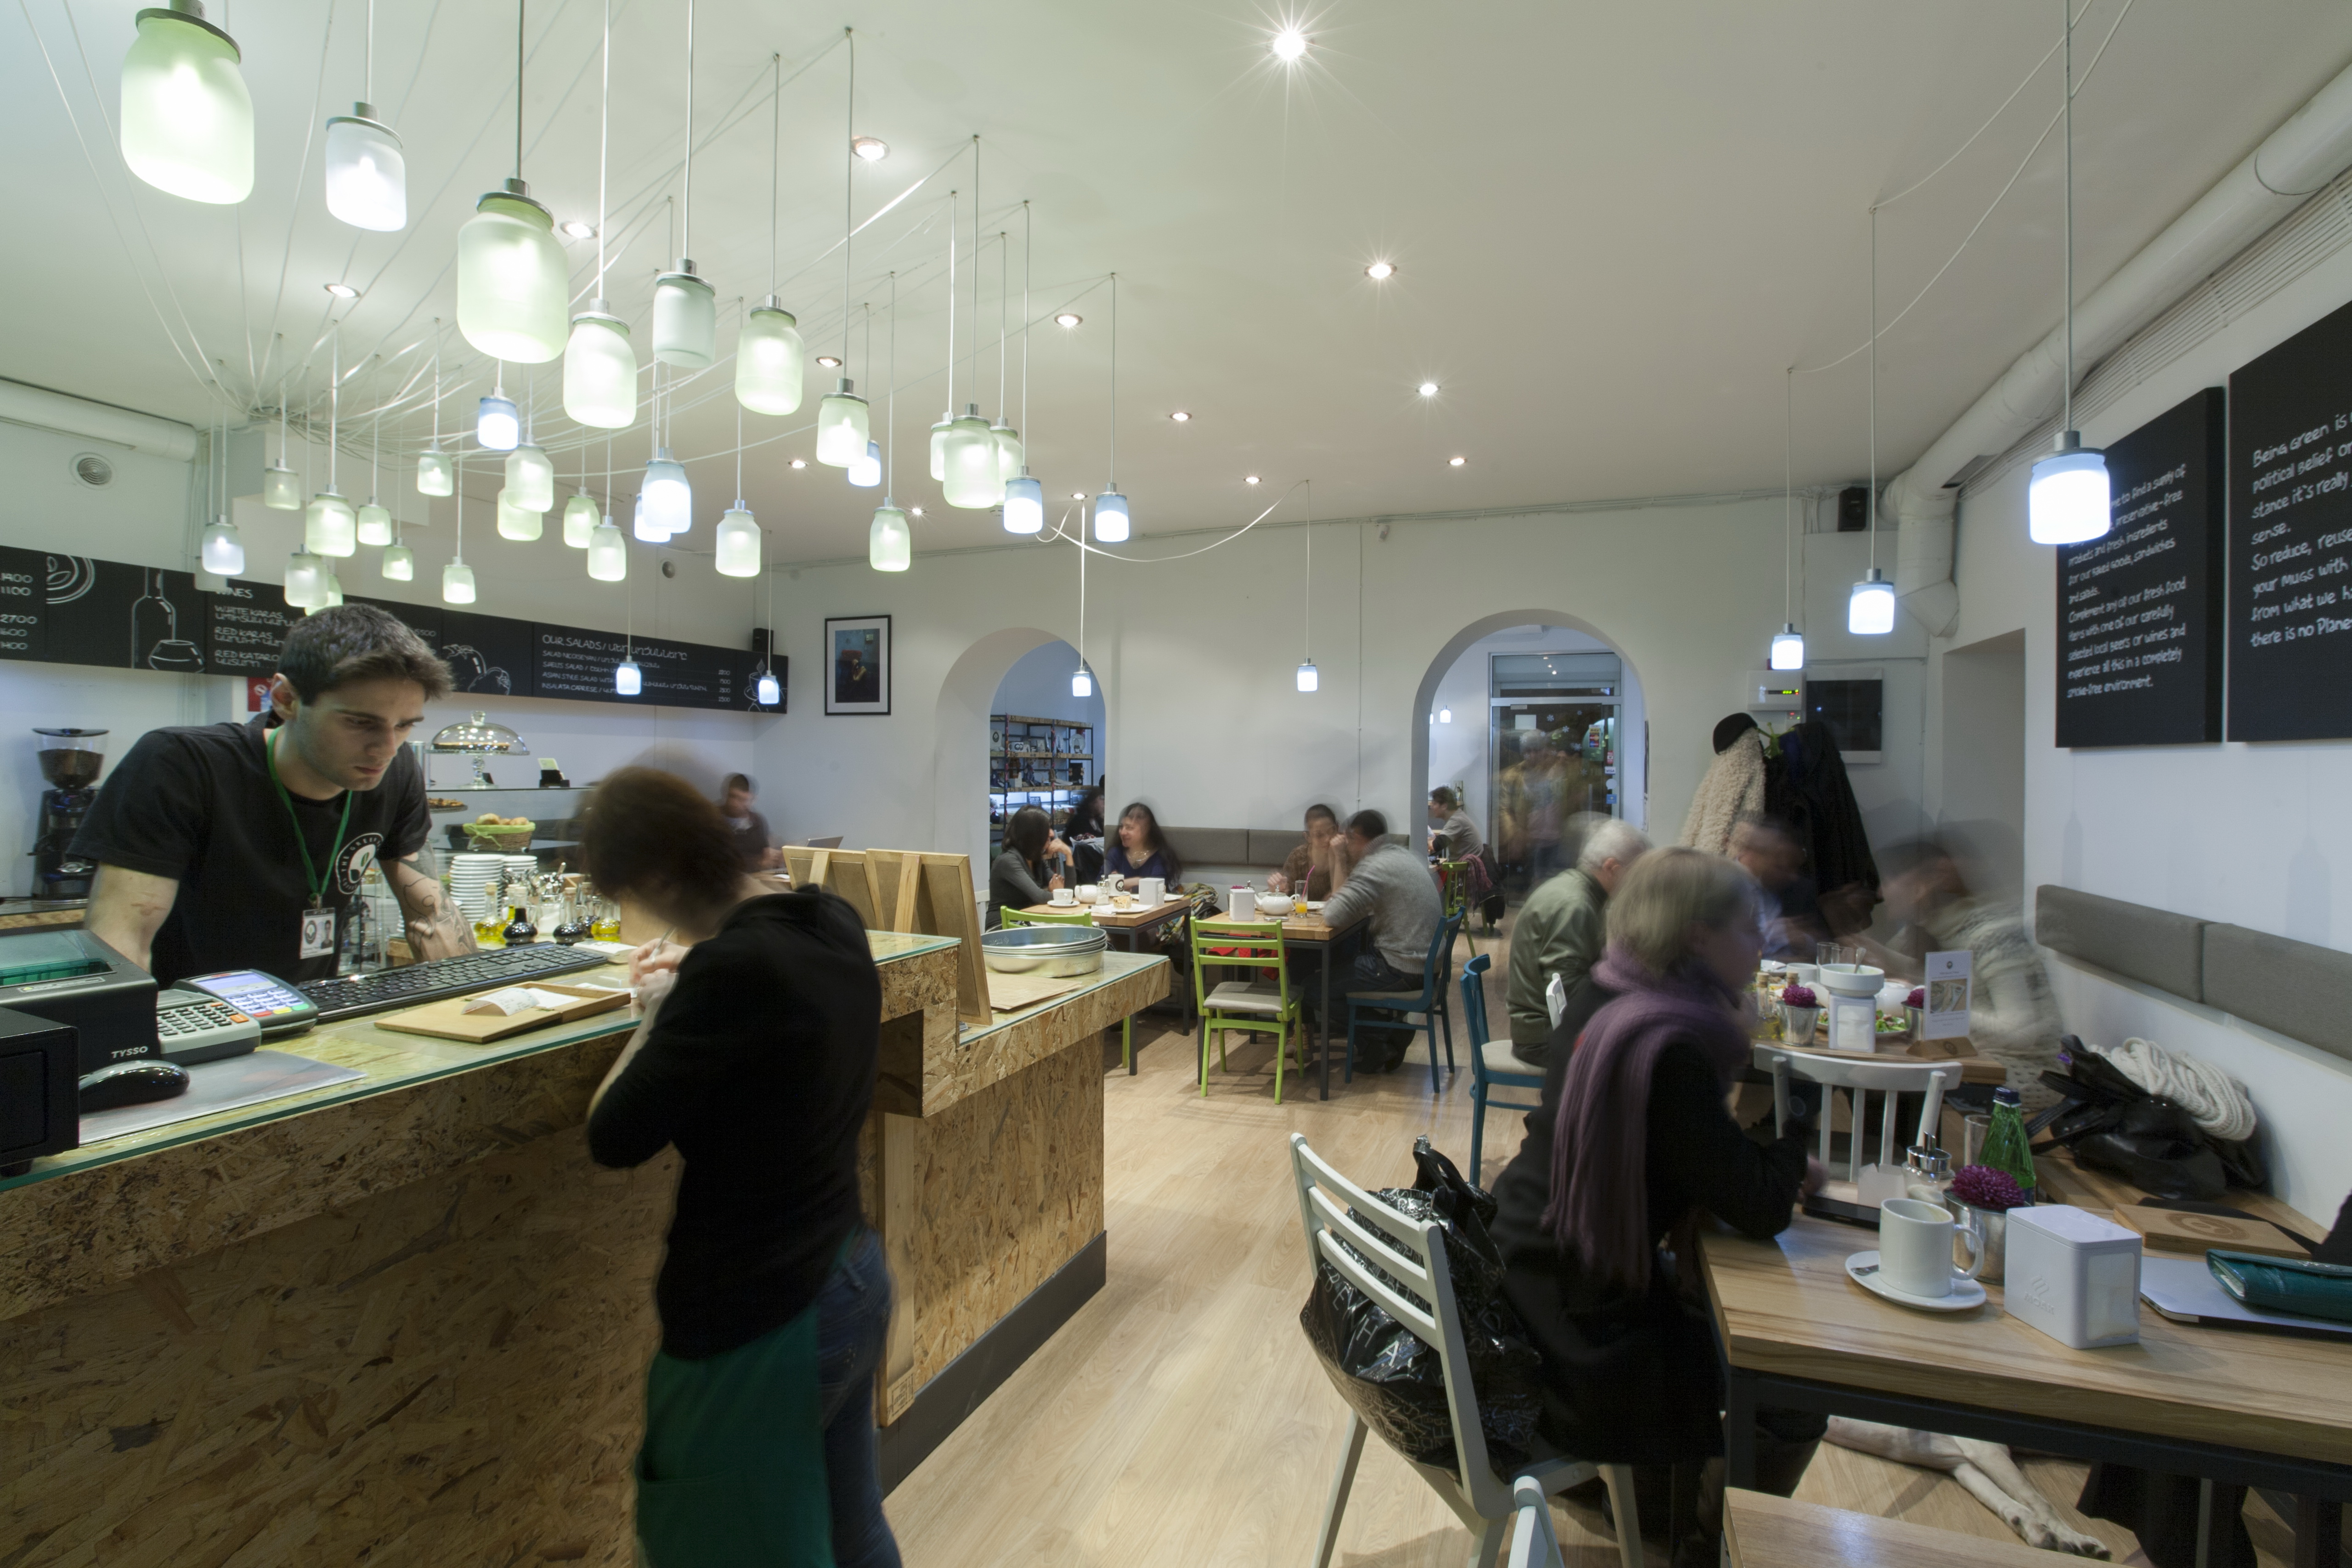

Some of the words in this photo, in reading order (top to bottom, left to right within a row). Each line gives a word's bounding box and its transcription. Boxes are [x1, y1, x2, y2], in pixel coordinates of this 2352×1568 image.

[2335, 414, 2347, 431] is
[2253, 463, 2295, 494] political
[2251, 497, 2290, 519] stance
[2316, 471, 2349, 495] really
[2126, 519, 2168, 544] ingredients
[2251, 523, 2292, 545] sense.
[2251, 554, 2268, 571] So
[2269, 542, 2312, 564] reduce,
[2143, 583, 2165, 601] fresh
[2165, 575, 2186, 594] food
[2252, 578, 2278, 599] your
[2318, 557, 2349, 576] with
[214, 605, 249, 615] WHITE
[250, 608, 284, 619] KARAS
[2284, 594, 2314, 613] what
[2317, 592, 2337, 606] we
[2100, 621, 2114, 633] one
[2114, 615, 2125, 629] of
[2125, 613, 2139, 626] our
[2140, 604, 2174, 623] carefully
[214, 626, 238, 635] RED
[239, 629, 273, 639] KARAS
[542, 634, 564, 646] OUR
[565, 637, 602, 650] SALADS
[2093, 641, 2109, 655] local
[2132, 634, 2144, 646] or
[2144, 630, 2169, 644] wines
[2170, 622, 2186, 639] and
[2250, 631, 2282, 647] there
[2284, 626, 2296, 641] is
[2298, 625, 2315, 637] no
[214, 649, 238, 658] RED
[2068, 665, 2101, 679] experience
[2102, 659, 2111, 673] all
[2111, 658, 2125, 672] this
[2126, 657, 2133, 668] in
[2142, 646, 2183, 665] completely
[111, 1046, 148, 1059] TYSSO
